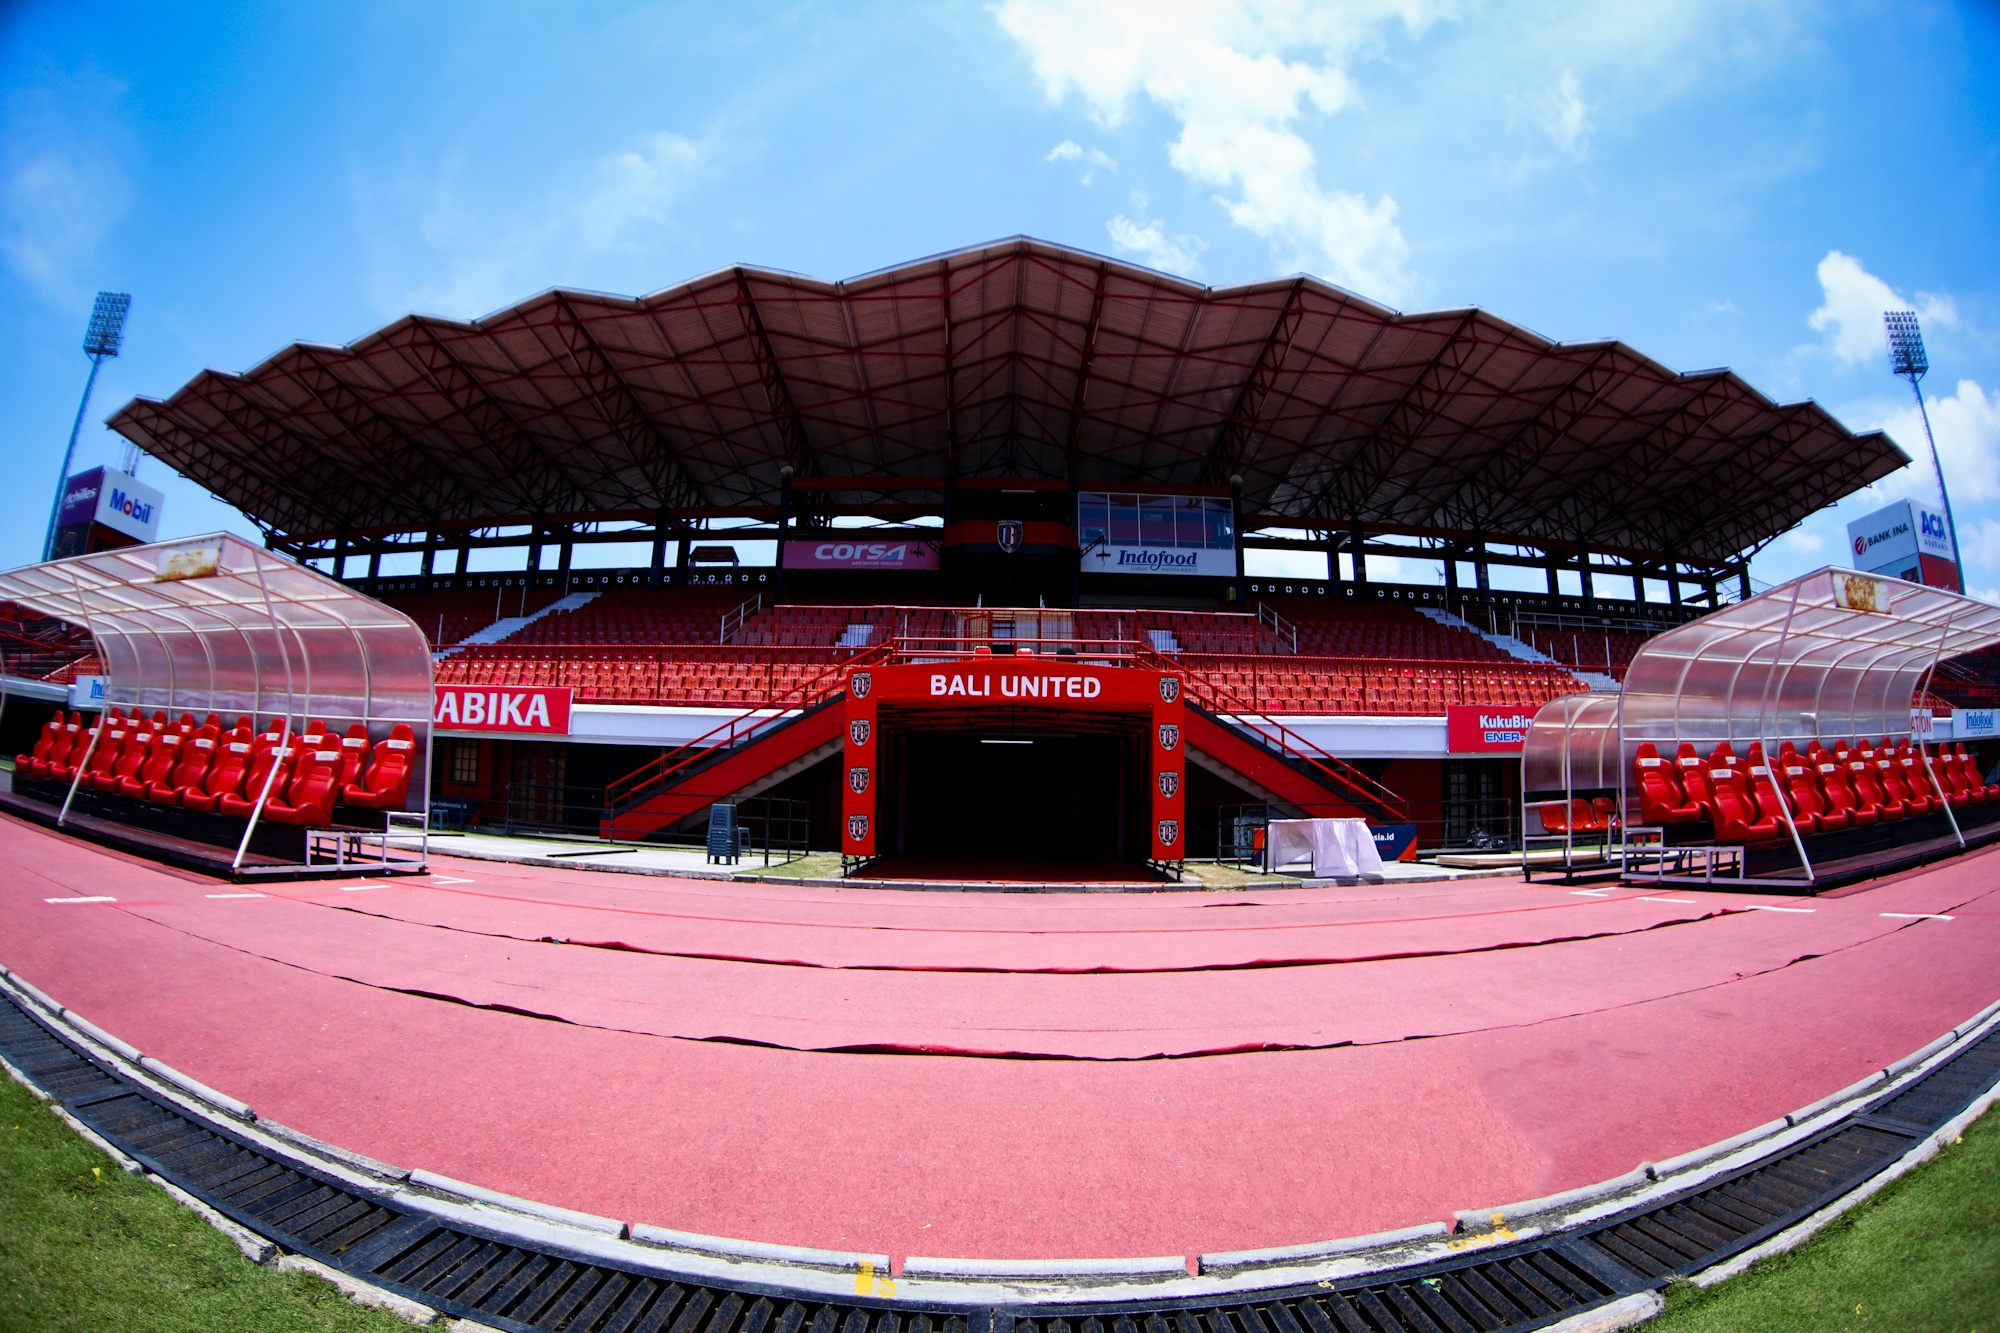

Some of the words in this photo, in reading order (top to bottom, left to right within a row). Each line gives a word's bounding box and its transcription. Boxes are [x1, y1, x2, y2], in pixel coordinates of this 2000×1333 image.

[109, 488, 151, 524] Mobil
[1867, 529, 1891, 547] BANK
[1893, 522, 1909, 537] INA
[1921, 510, 1947, 540] ACA
[1117, 549, 1198, 571] Indofood
[930, 674, 990, 696] BALI
[1001, 676, 1101, 698] UNITED
[433, 691, 551, 727] ABIKA
[1910, 716, 1932, 733] ATON
[1965, 711, 1994, 735] Indofood
